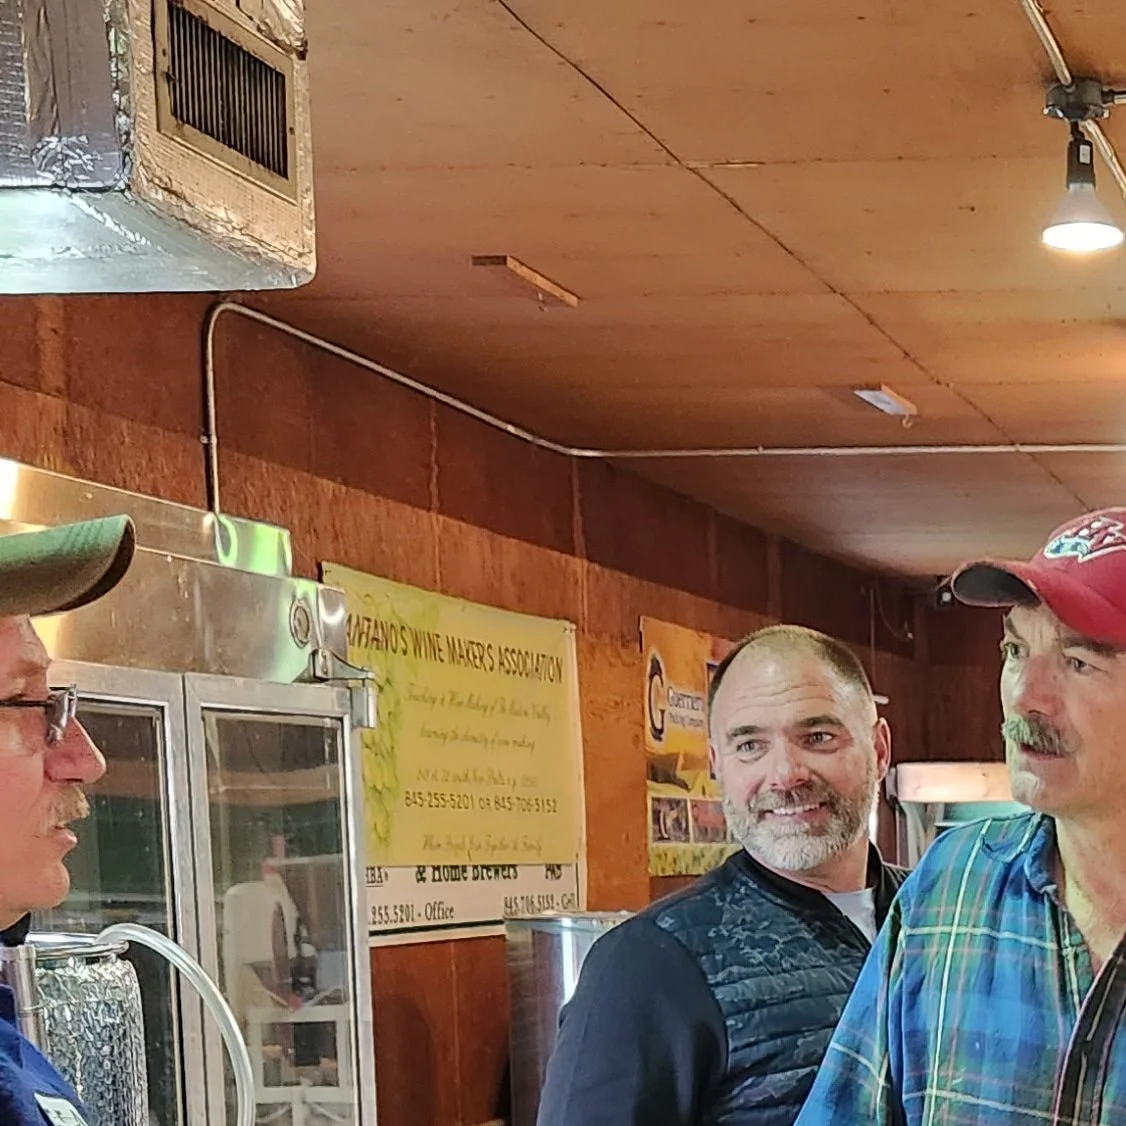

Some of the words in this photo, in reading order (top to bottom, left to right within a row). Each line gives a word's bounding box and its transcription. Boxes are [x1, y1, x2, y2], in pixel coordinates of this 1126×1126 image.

[409, 627, 444, 663] WINE
[498, 645, 564, 684] ASSOCIATION
[405, 790, 474, 810] 845-255-5201
[431, 864, 467, 883] Home
[472, 864, 519, 881] Brewers
[424, 901, 454, 921] Office
